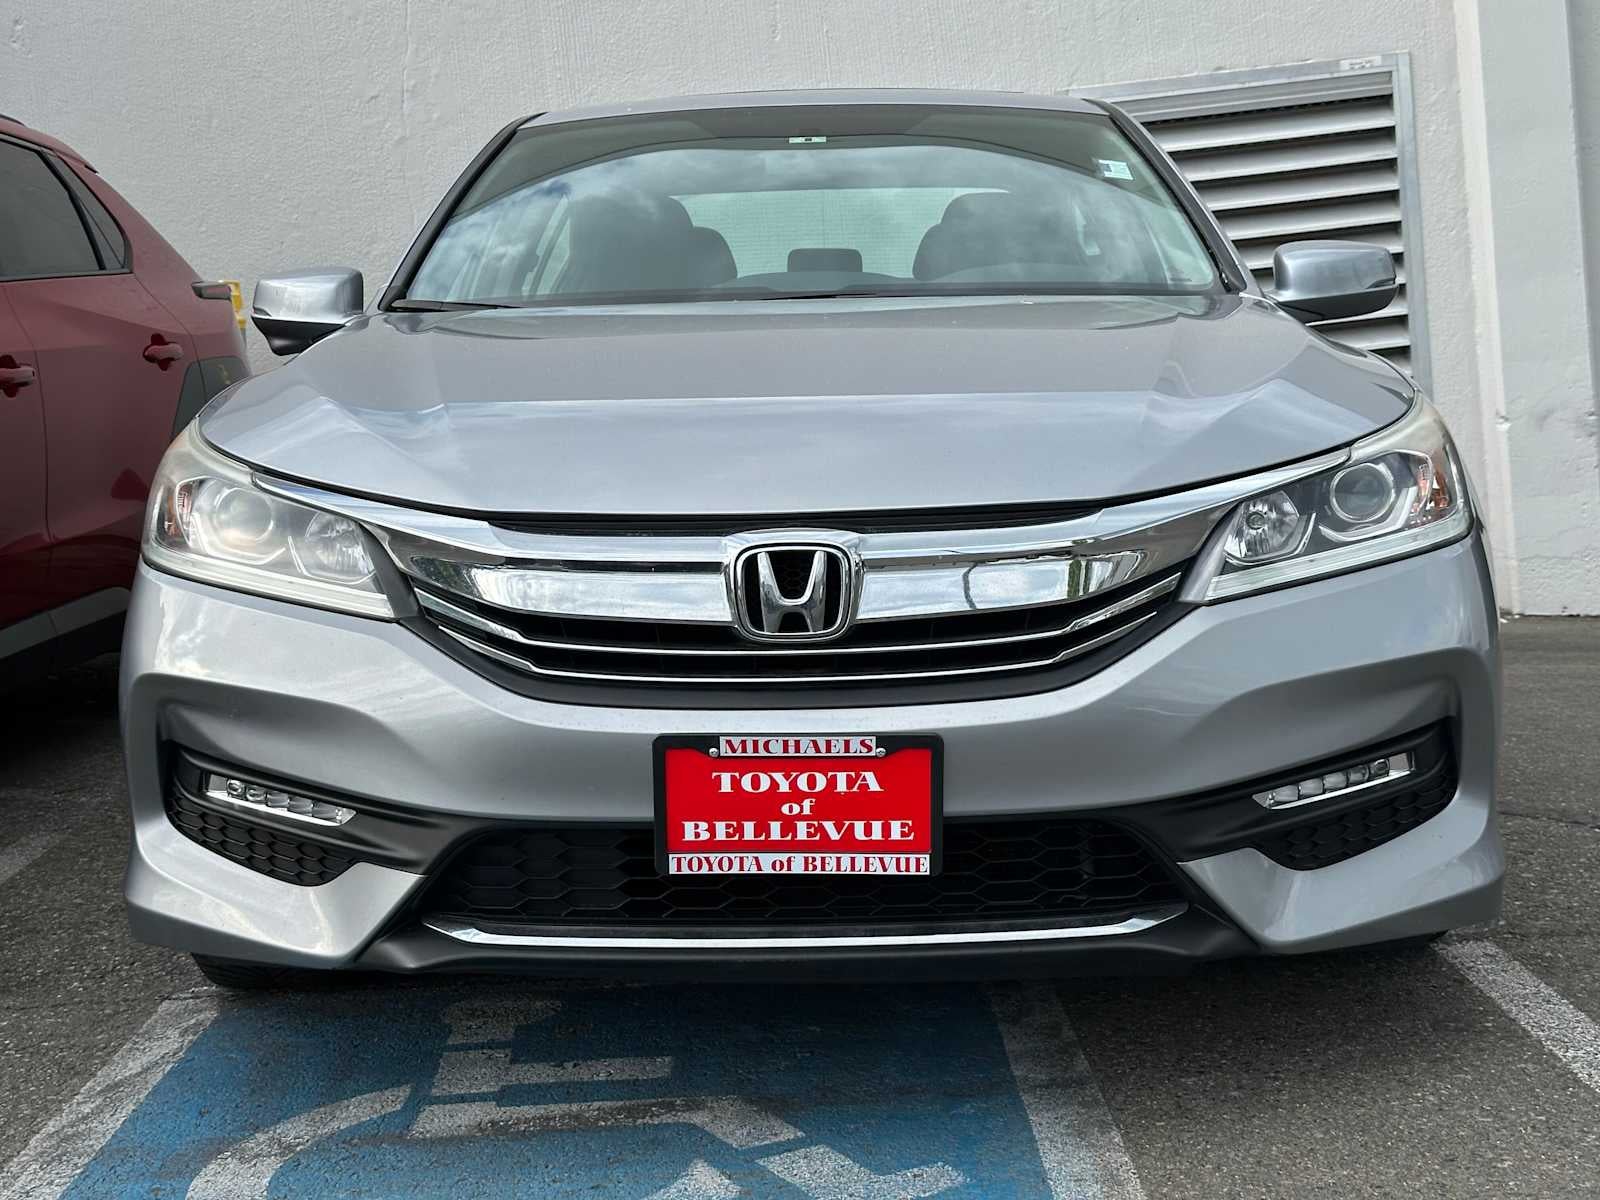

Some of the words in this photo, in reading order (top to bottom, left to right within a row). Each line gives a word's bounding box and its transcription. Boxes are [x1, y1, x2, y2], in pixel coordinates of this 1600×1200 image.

[724, 738, 875, 755] MICHAELS
[711, 771, 885, 793] TOYOTA
[781, 798, 817, 816] of
[681, 820, 916, 842] BELLEVUE
[671, 855, 763, 873] TOYOTA
[770, 855, 796, 872] of
[803, 856, 928, 873] BELLEVUE
